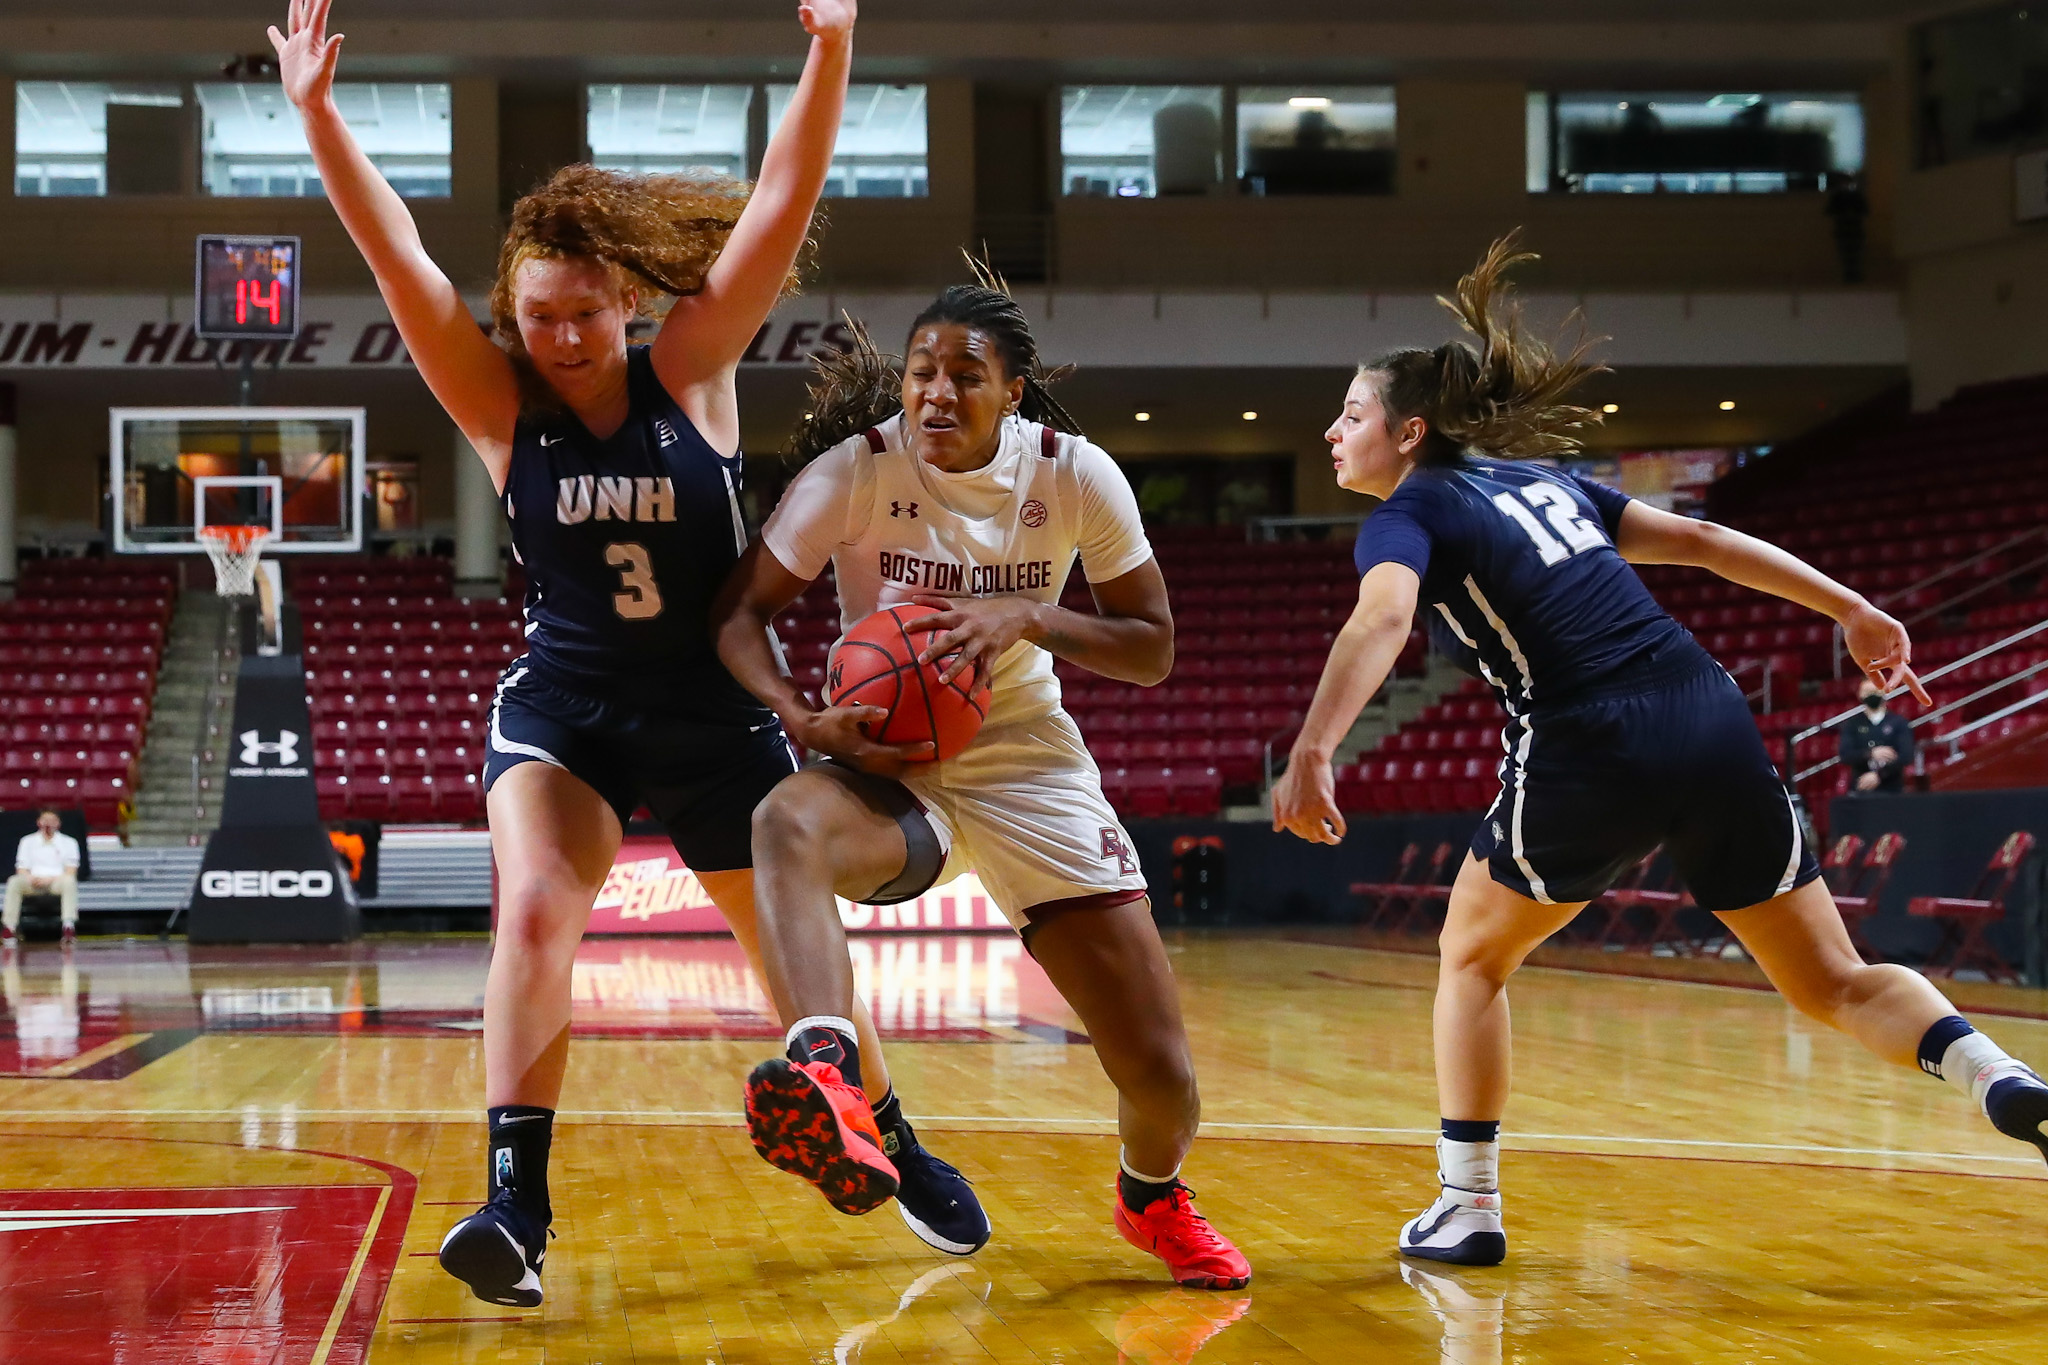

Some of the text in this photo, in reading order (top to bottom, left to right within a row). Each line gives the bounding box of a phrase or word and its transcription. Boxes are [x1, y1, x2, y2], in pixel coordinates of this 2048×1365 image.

[236, 279, 281, 325] 14
[556, 474, 678, 526] UNH
[1492, 481, 1609, 568] 12
[604, 542, 664, 620] 3
[879, 551, 1052, 595] BOSTON COLLEGE
[201, 870, 333, 898] GEICO
